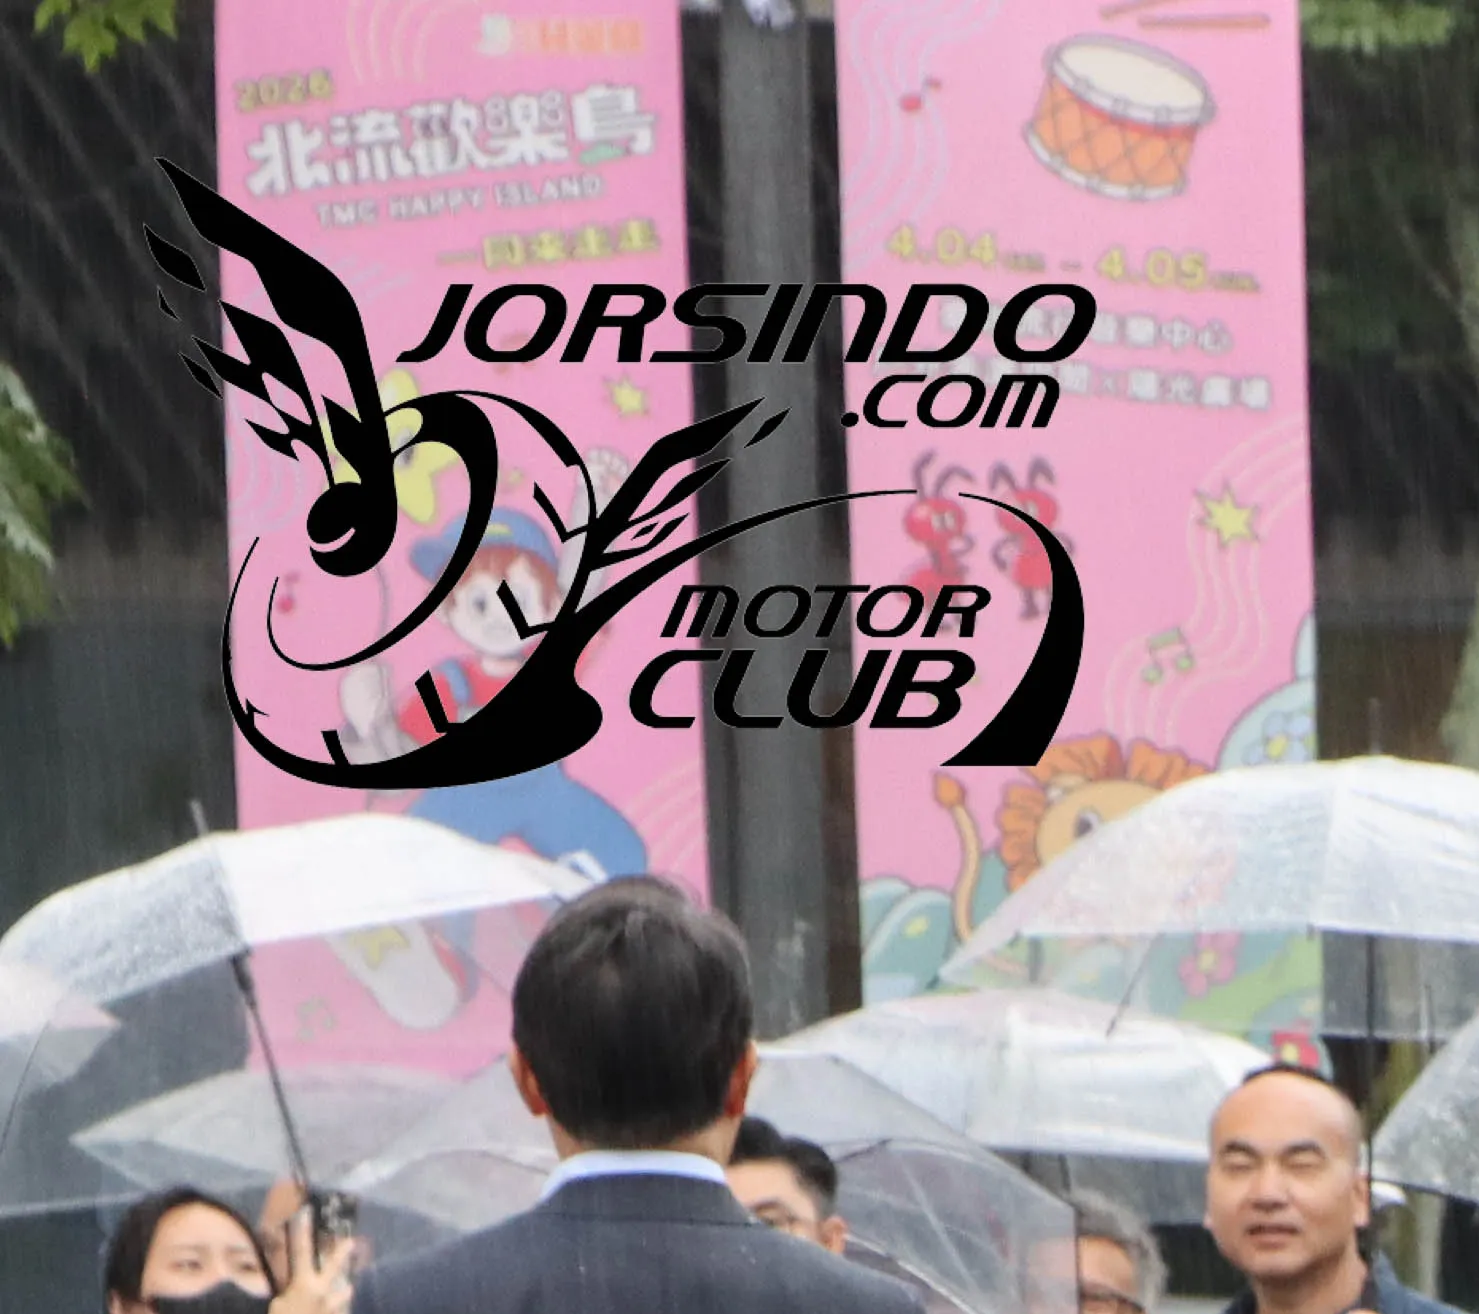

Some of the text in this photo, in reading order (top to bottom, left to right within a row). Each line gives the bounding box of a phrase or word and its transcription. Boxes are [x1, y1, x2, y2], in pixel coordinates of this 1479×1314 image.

[235, 68, 334, 111] 2026
[246, 84, 656, 197] 北流歡樂島
[389, 185, 485, 219] HAPPY
[496, 174, 605, 208] ISLAND
